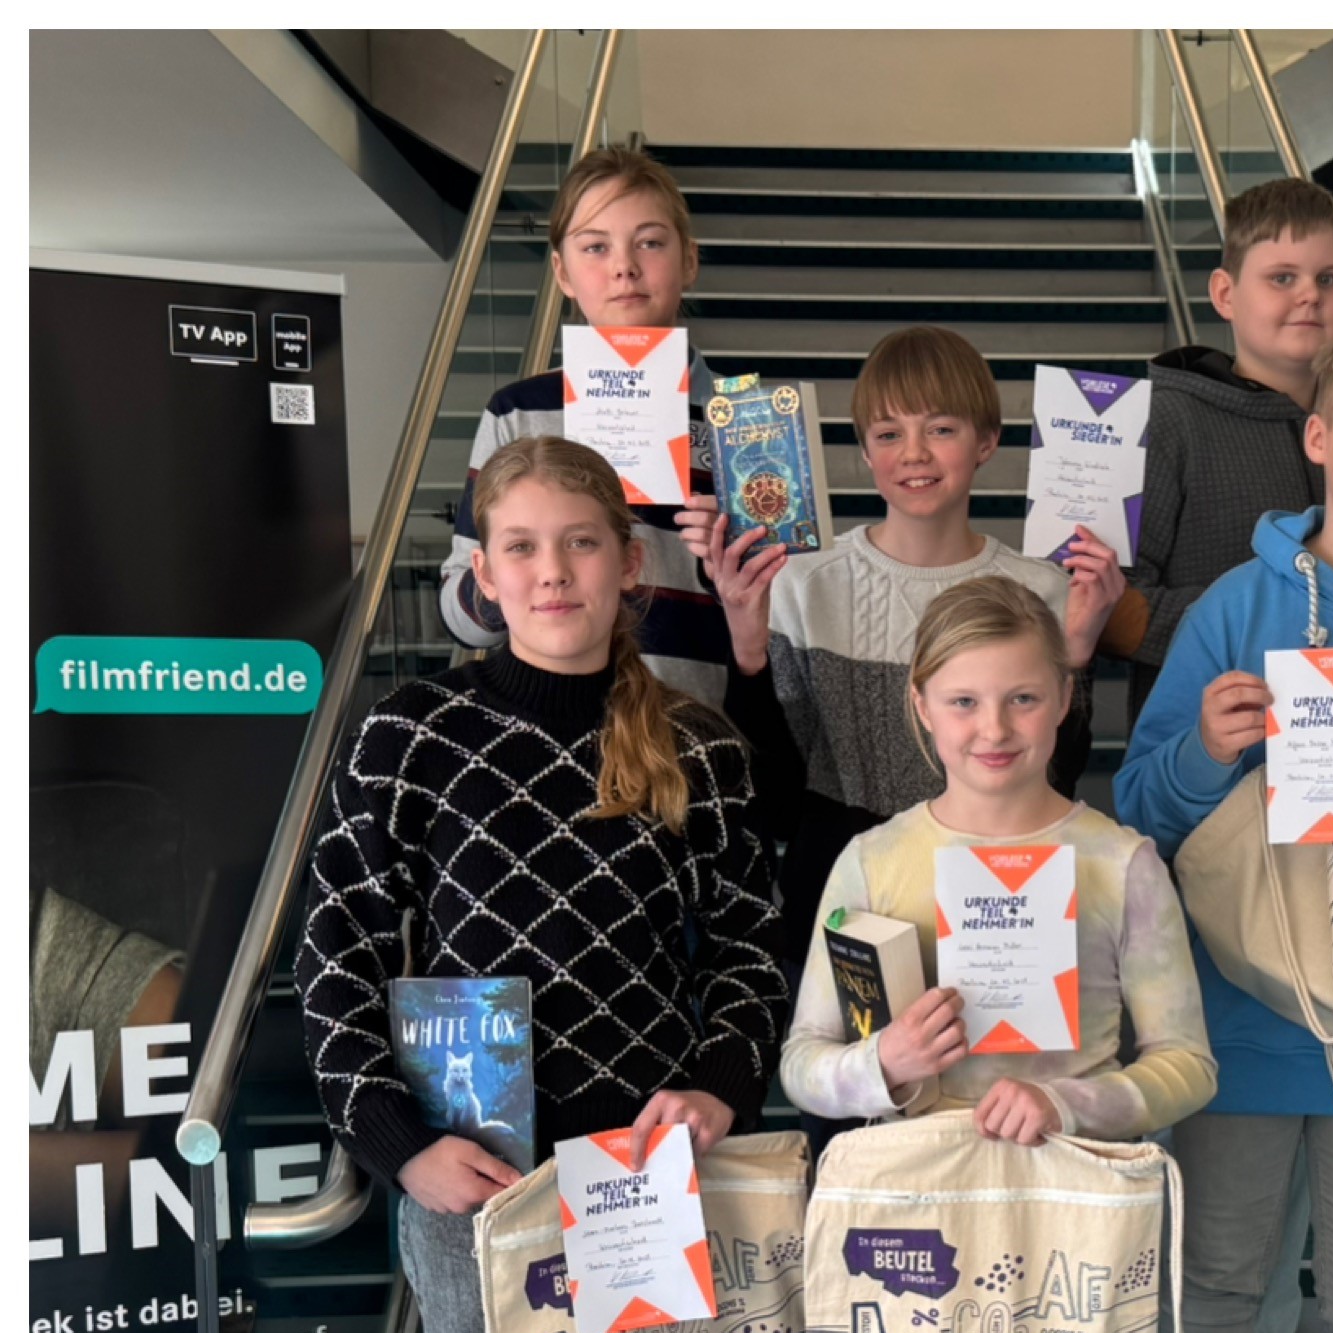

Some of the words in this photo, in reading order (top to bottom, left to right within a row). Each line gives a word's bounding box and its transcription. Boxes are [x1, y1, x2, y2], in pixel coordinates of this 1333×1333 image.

[178, 323, 206, 340] TV
[210, 326, 248, 347] App
[283, 341, 303, 353] App
[588, 369, 645, 381] URKUNDE
[602, 378, 624, 388] TEIL
[1051, 416, 1104, 434] URKUNDE
[59, 657, 307, 695] filmfriend.de
[1308, 706, 1332, 717] TEIL
[964, 896, 1028, 908] URKUNDE
[980, 906, 1005, 918] TEIL
[402, 1016, 470, 1048] WHITE
[481, 1012, 517, 1042] FOX
[586, 1172, 650, 1196] URKUNDE
[603, 1187, 627, 1202] TEIL
[874, 1250, 936, 1272] BEUTEL
[85, 1302, 129, 1333] ist
